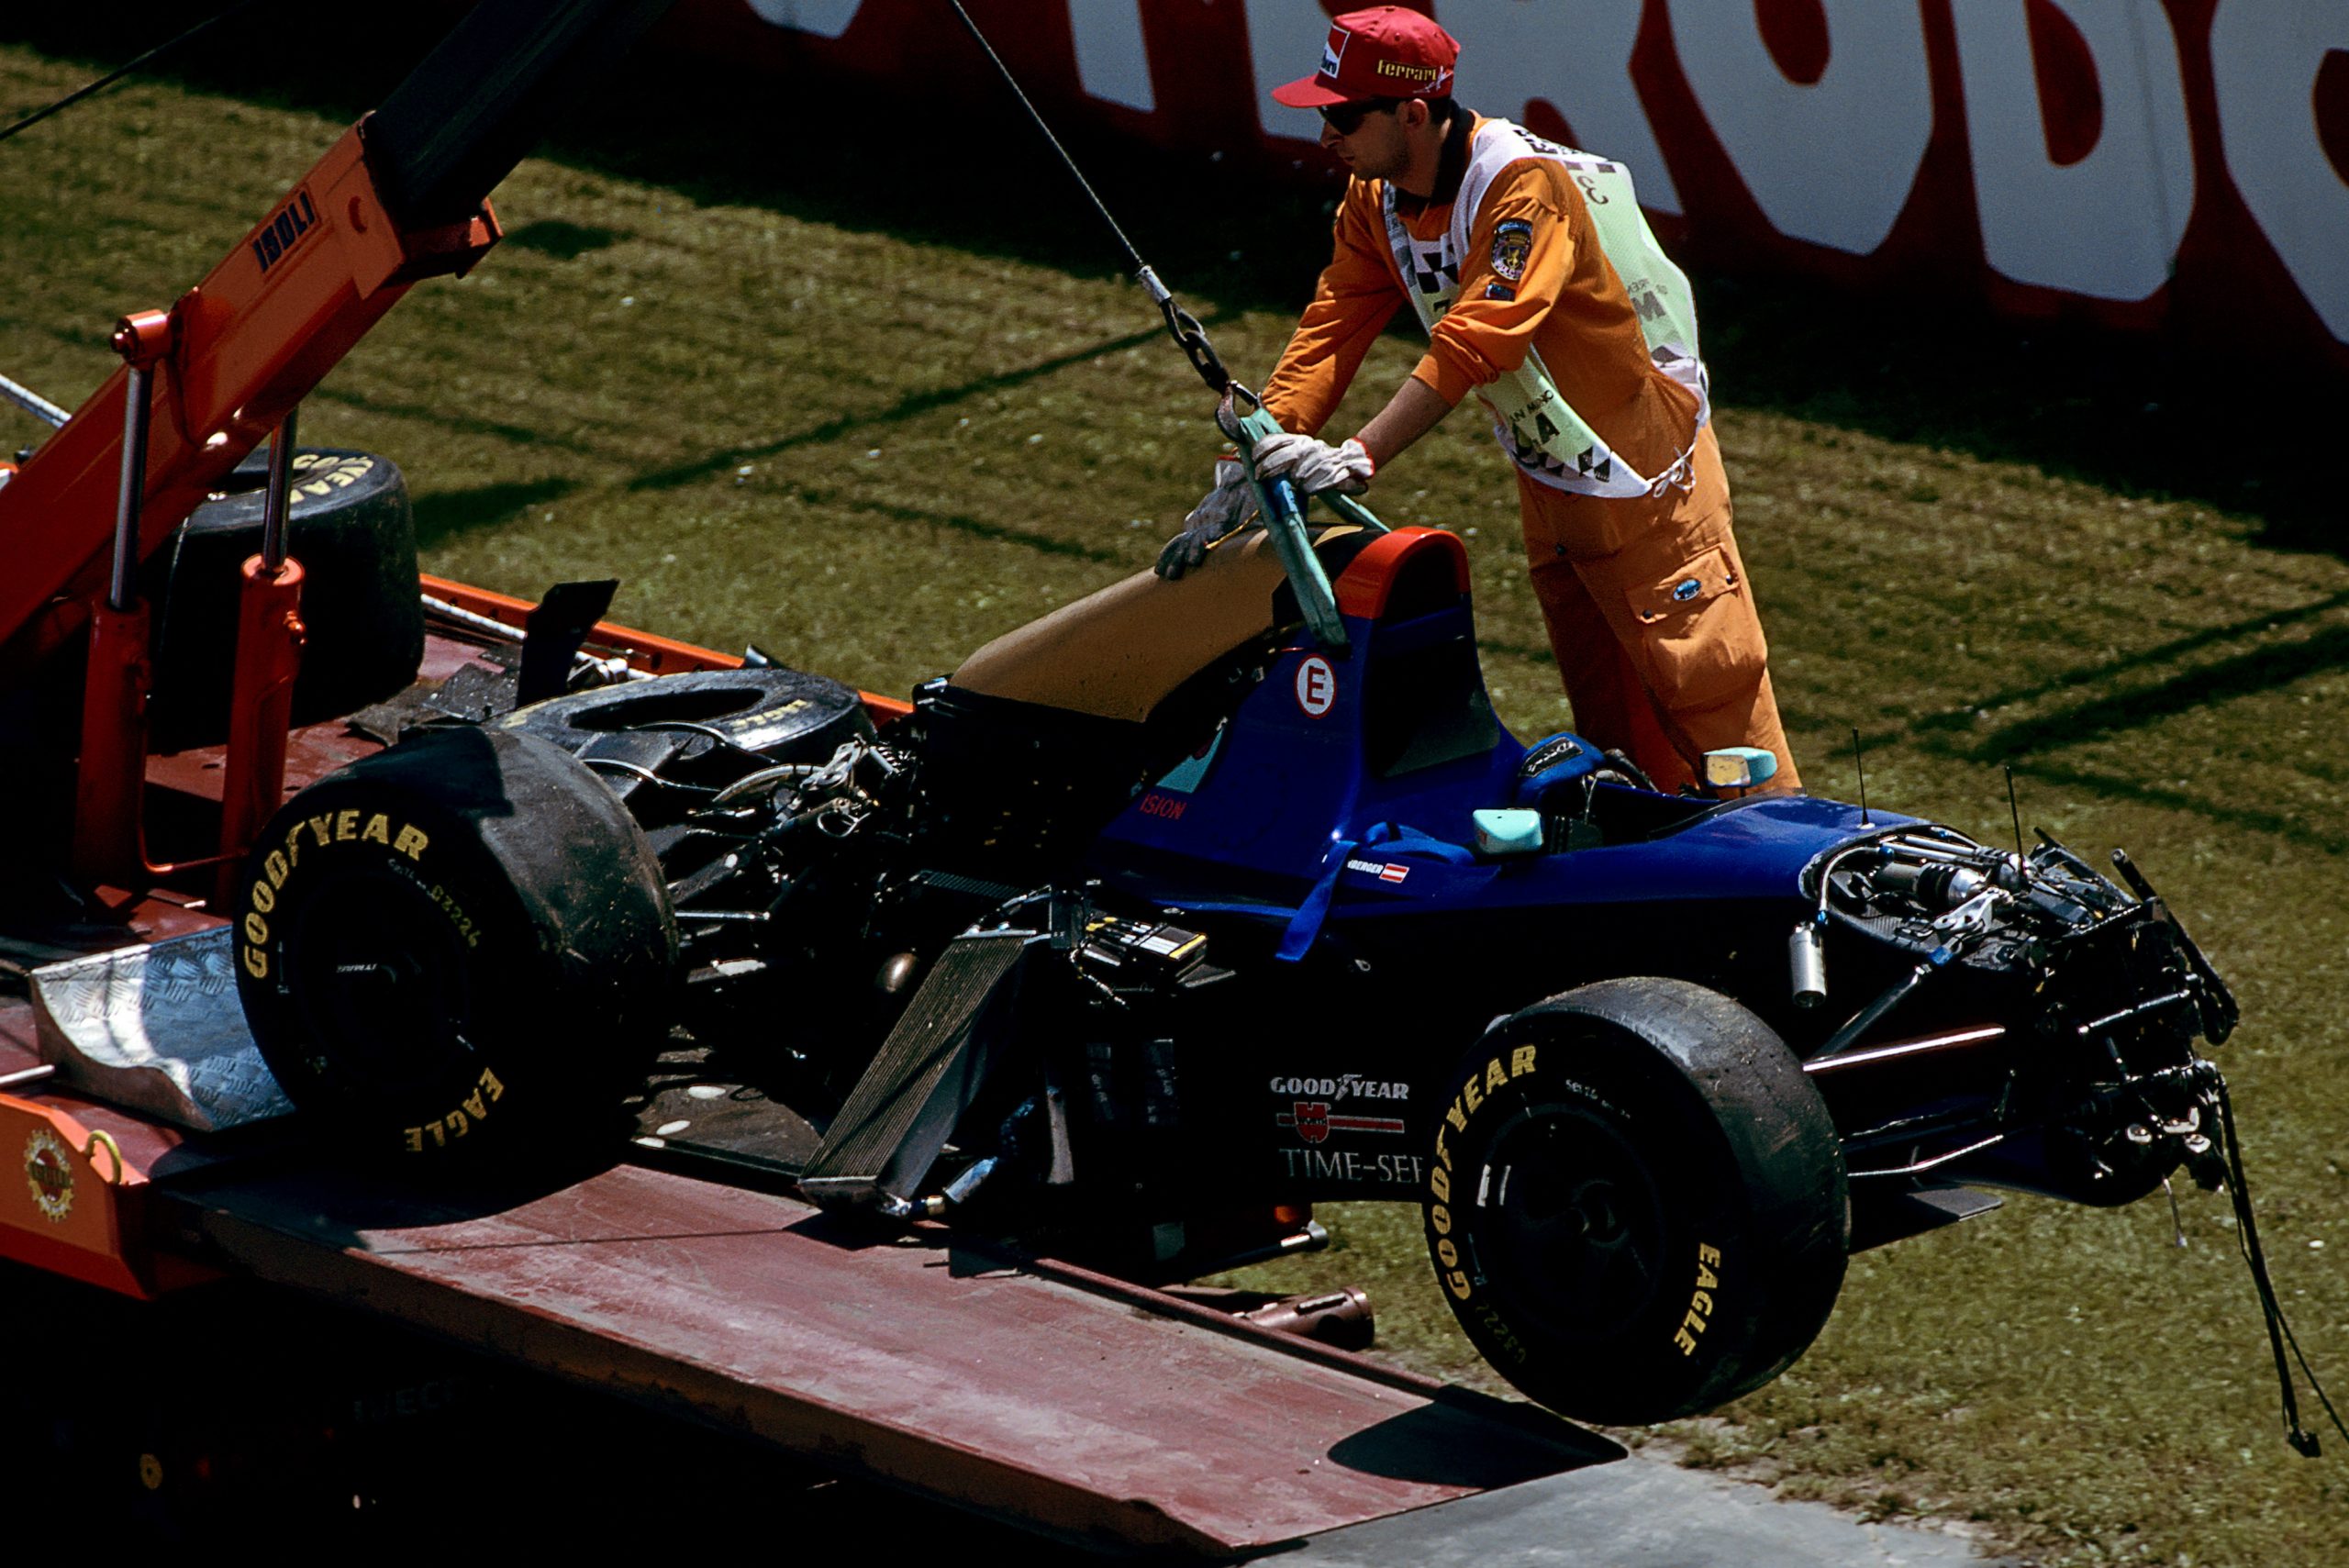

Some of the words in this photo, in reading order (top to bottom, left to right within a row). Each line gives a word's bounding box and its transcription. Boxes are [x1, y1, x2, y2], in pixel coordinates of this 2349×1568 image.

[1376, 59, 1439, 82] Ferrari
[252, 190, 315, 273] ISOLI
[1307, 664, 1326, 705] E
[242, 807, 431, 981] GOODYEAR
[401, 1066, 507, 1154] EAGLE
[1269, 1073, 1411, 1102] GOODYEAR
[1430, 1042, 1539, 1301] GOODYEAR
[1672, 1240, 1724, 1358] EAGLE
